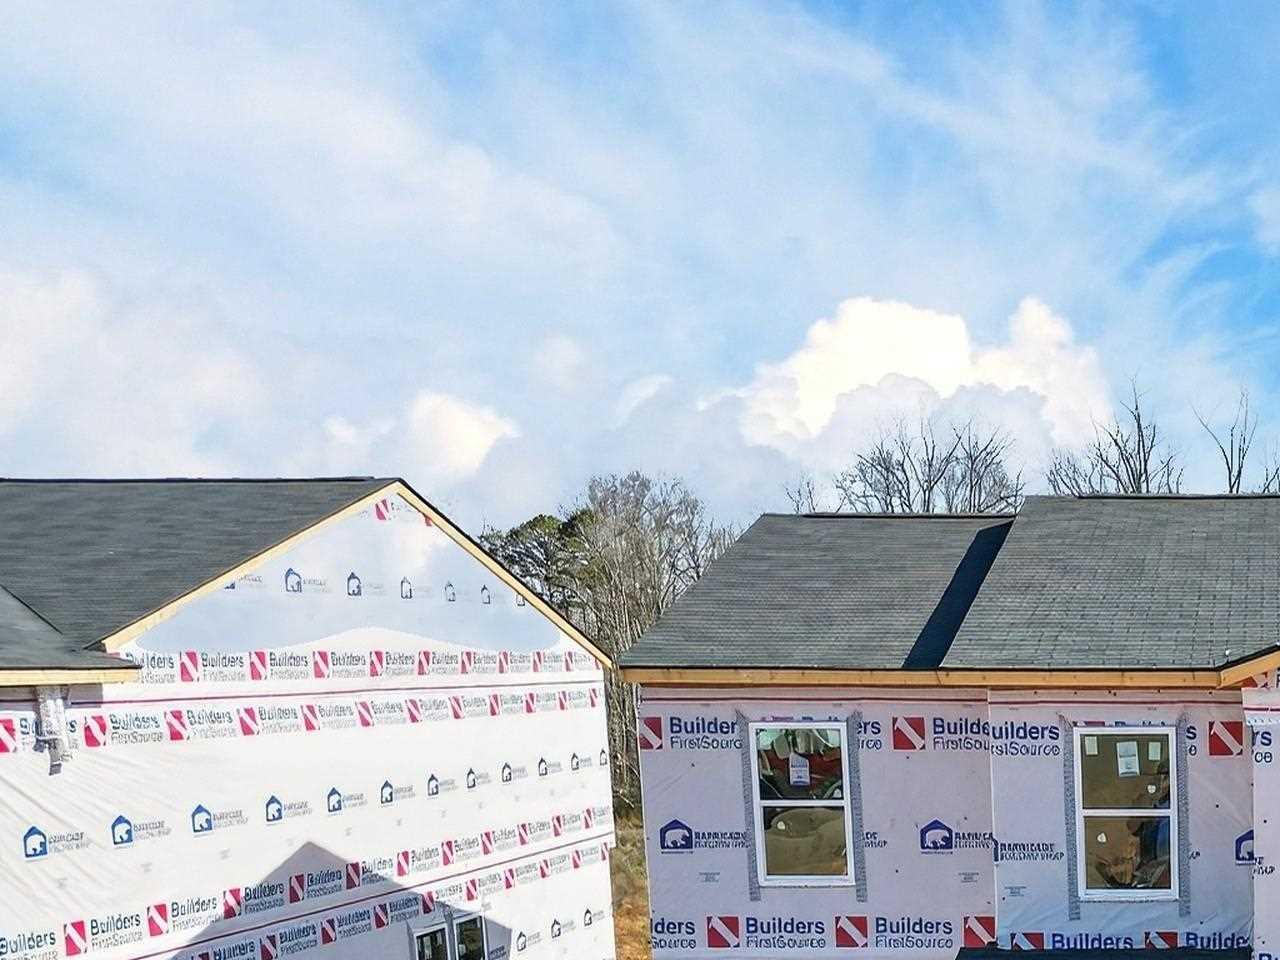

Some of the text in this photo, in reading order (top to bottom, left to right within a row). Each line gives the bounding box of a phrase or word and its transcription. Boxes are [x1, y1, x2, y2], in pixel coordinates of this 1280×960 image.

[669, 716, 738, 736] Builder
[990, 721, 1060, 745] uilders
[90, 913, 141, 936] Builders
[745, 917, 827, 935] Builders
[874, 917, 954, 935] Builders
[745, 936, 827, 950] FirstSource
[874, 936, 954, 951] FirstSource
